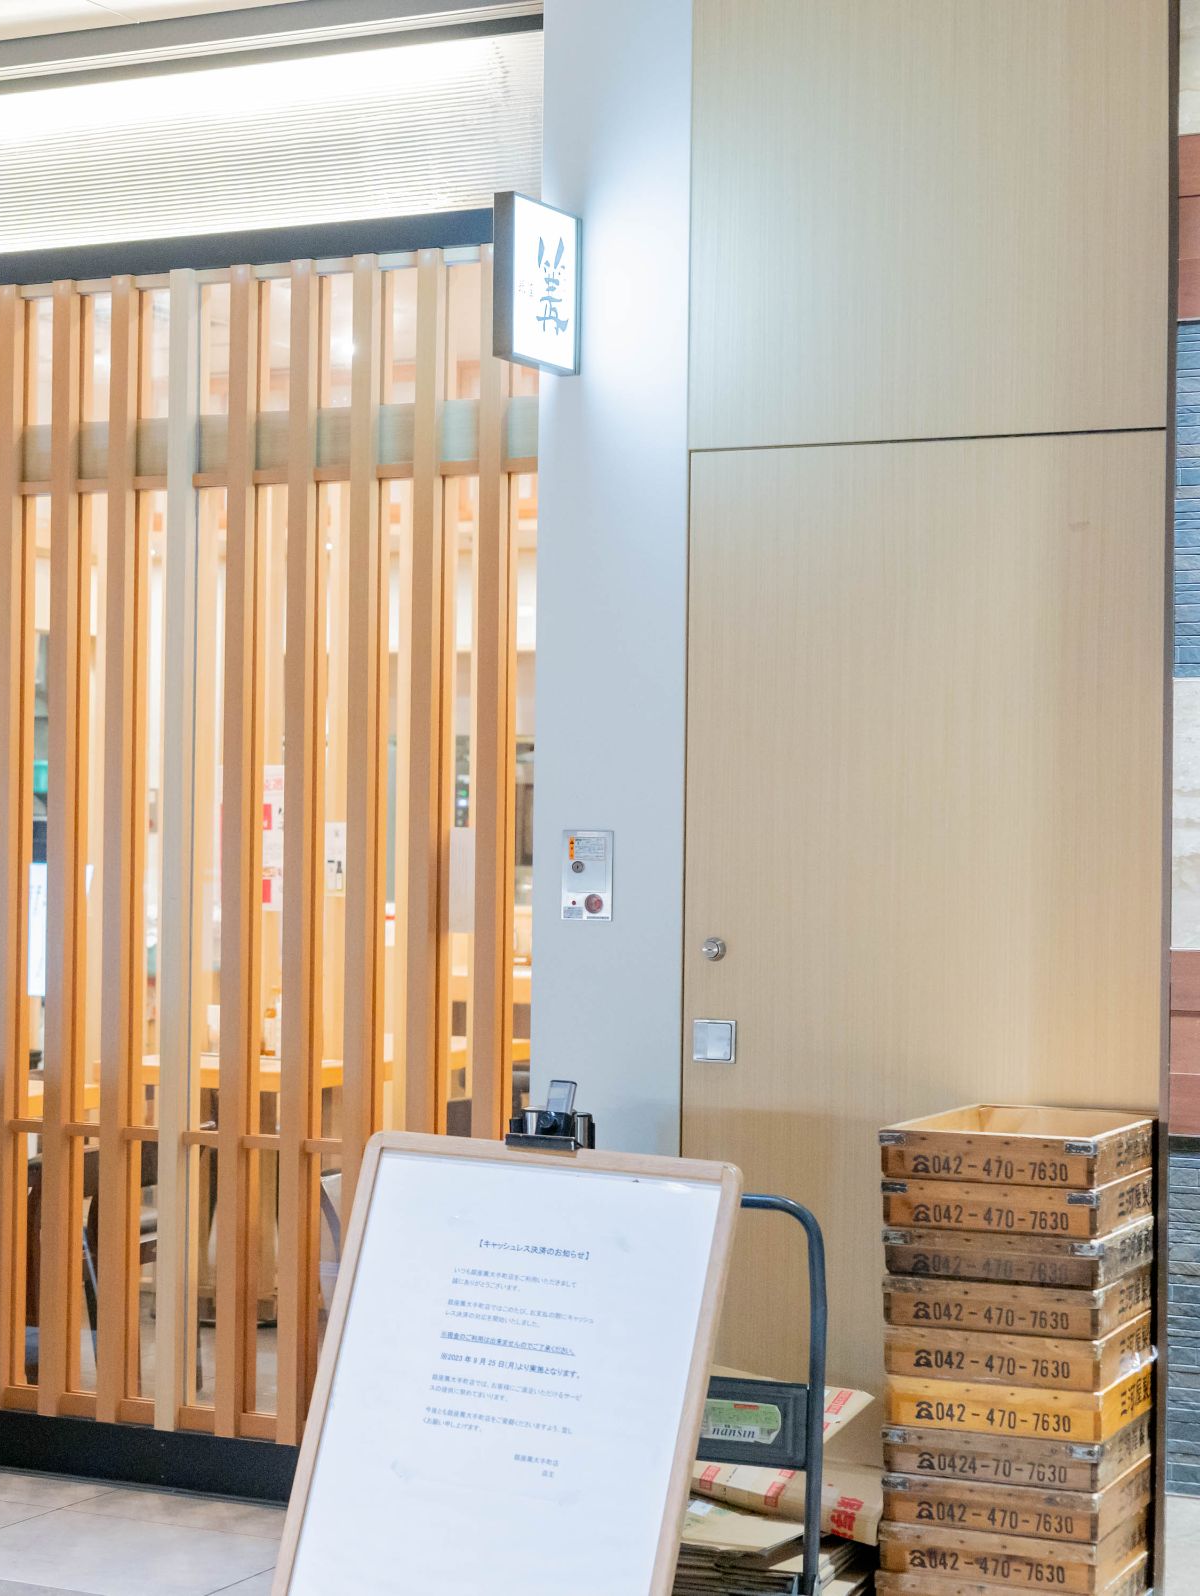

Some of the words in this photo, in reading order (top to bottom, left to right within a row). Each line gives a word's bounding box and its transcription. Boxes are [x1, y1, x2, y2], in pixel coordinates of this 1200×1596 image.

[479, 1239, 591, 1261] 【キャッシュレス決済のお知らせ】
[711, 1426, 756, 1440] nansin
